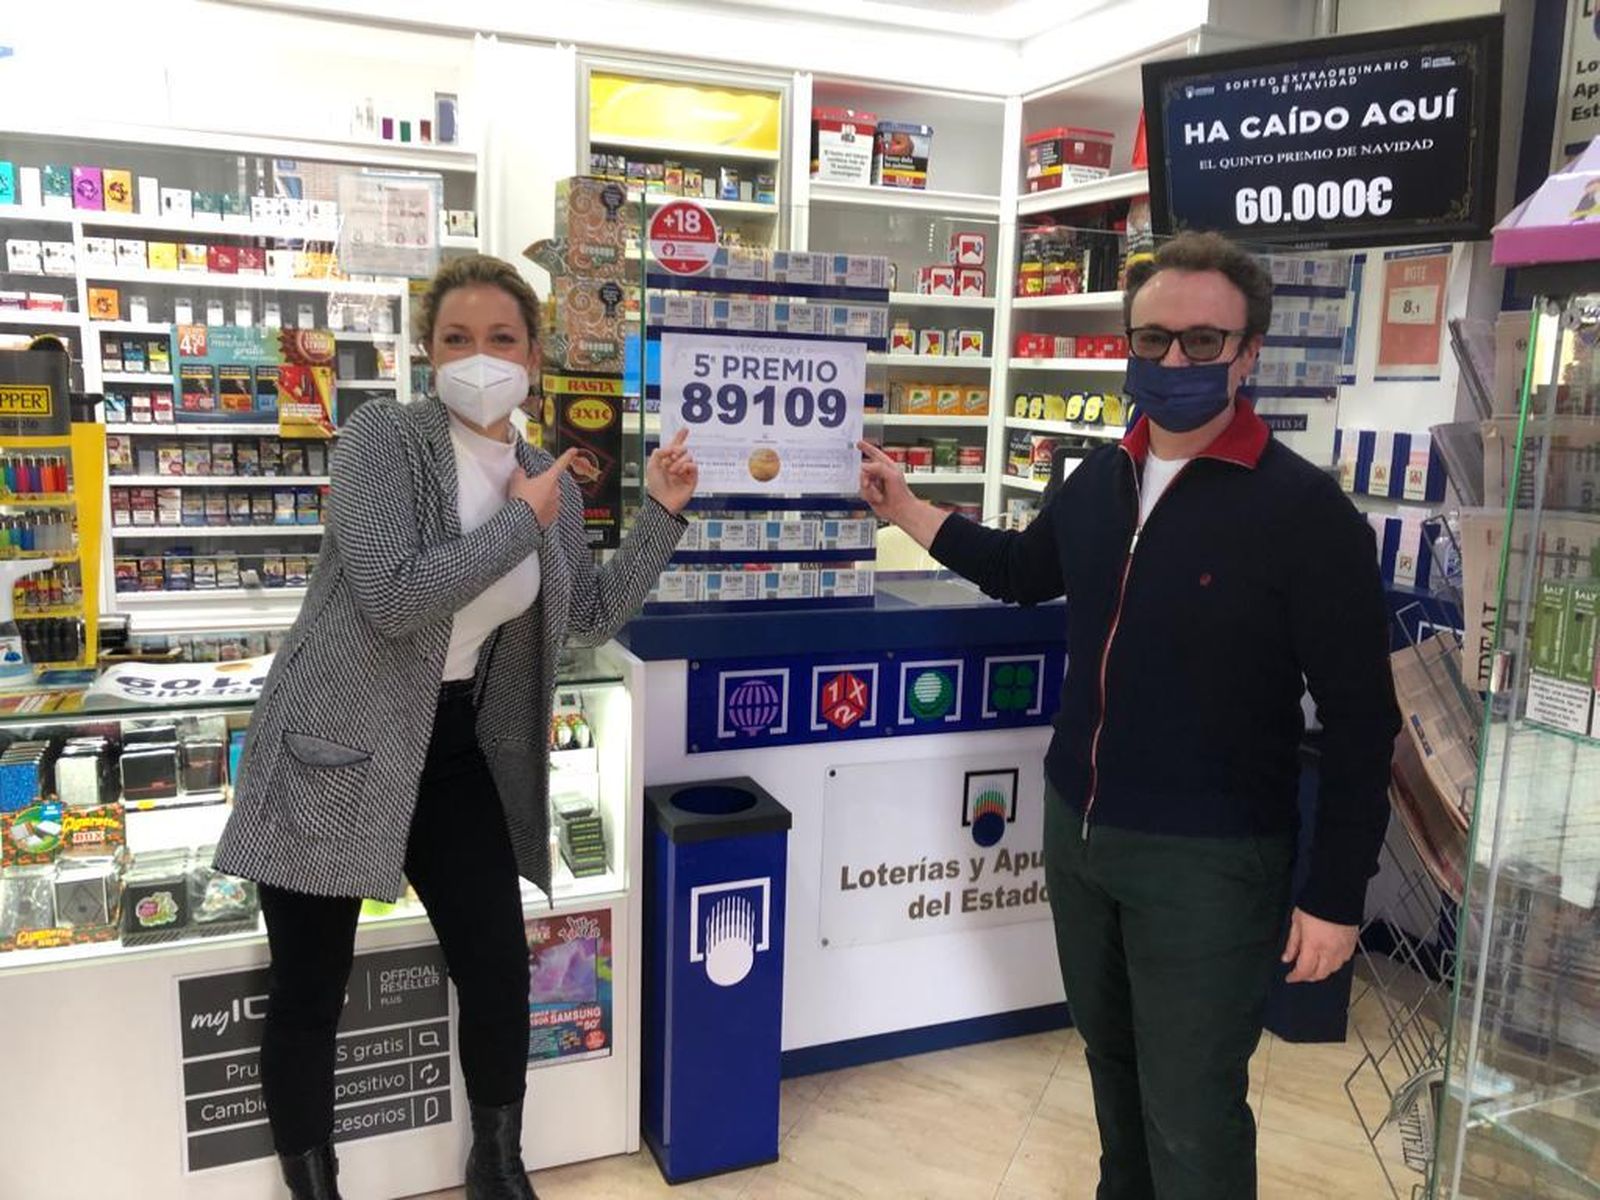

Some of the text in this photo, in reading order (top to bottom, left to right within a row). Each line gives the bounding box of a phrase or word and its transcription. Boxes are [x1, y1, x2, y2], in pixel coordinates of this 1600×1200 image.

[1225, 76, 1277, 91] SORTEO
[1283, 60, 1409, 85] EXTRAORDINARIO
[1271, 76, 1358, 95] DE NAVIDAD
[1184, 87, 1459, 145] HA CAÍDO AQUÍ
[1199, 138, 1435, 170] EL QUINTO PREMIO DE NAVIDAD
[1234, 176, 1394, 225] 60.000€
[663, 209, 701, 233] +18
[722, 355, 838, 384] PREMIO
[567, 379, 615, 393] RASTA
[681, 382, 847, 429] 89109
[841, 856, 961, 891] Loterías
[969, 856, 985, 882] y
[908, 891, 951, 920] del
[379, 965, 439, 983] OFFICIAL
[380, 976, 440, 994] RESELLER
[550, 1006, 601, 1024] SAMSUNG
[353, 1037, 404, 1062] gratis
